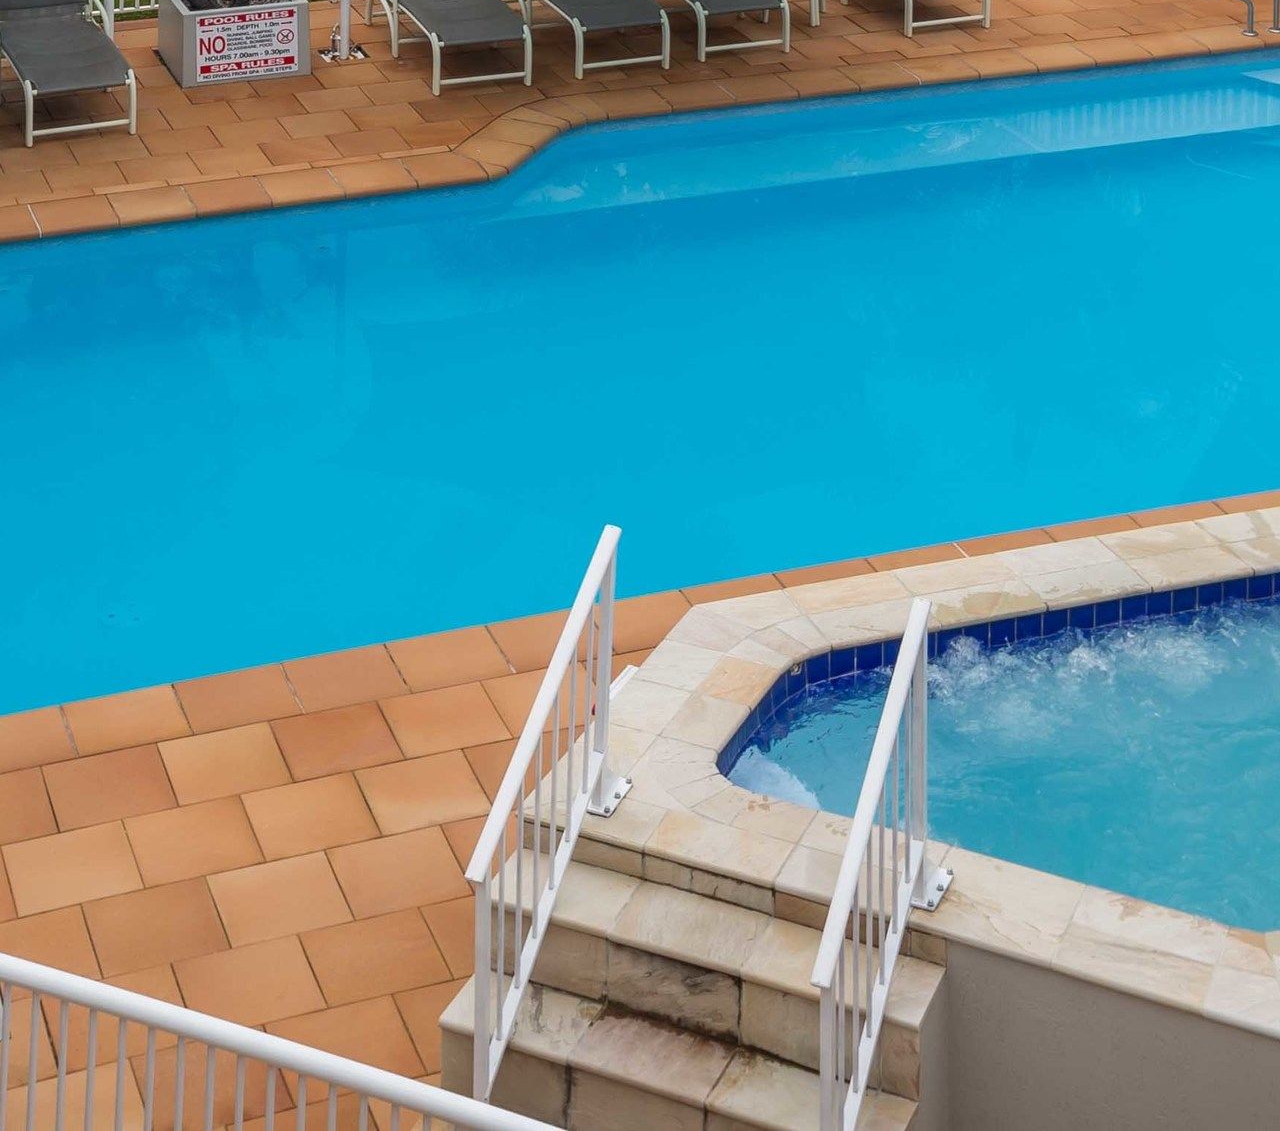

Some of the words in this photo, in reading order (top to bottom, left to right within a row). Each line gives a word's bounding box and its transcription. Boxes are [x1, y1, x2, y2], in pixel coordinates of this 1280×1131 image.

[204, 16, 243, 26] POOL
[246, 10, 289, 21] RULES
[199, 36, 226, 55] NO
[210, 63, 238, 72] SPA
[241, 58, 285, 68] RULES
